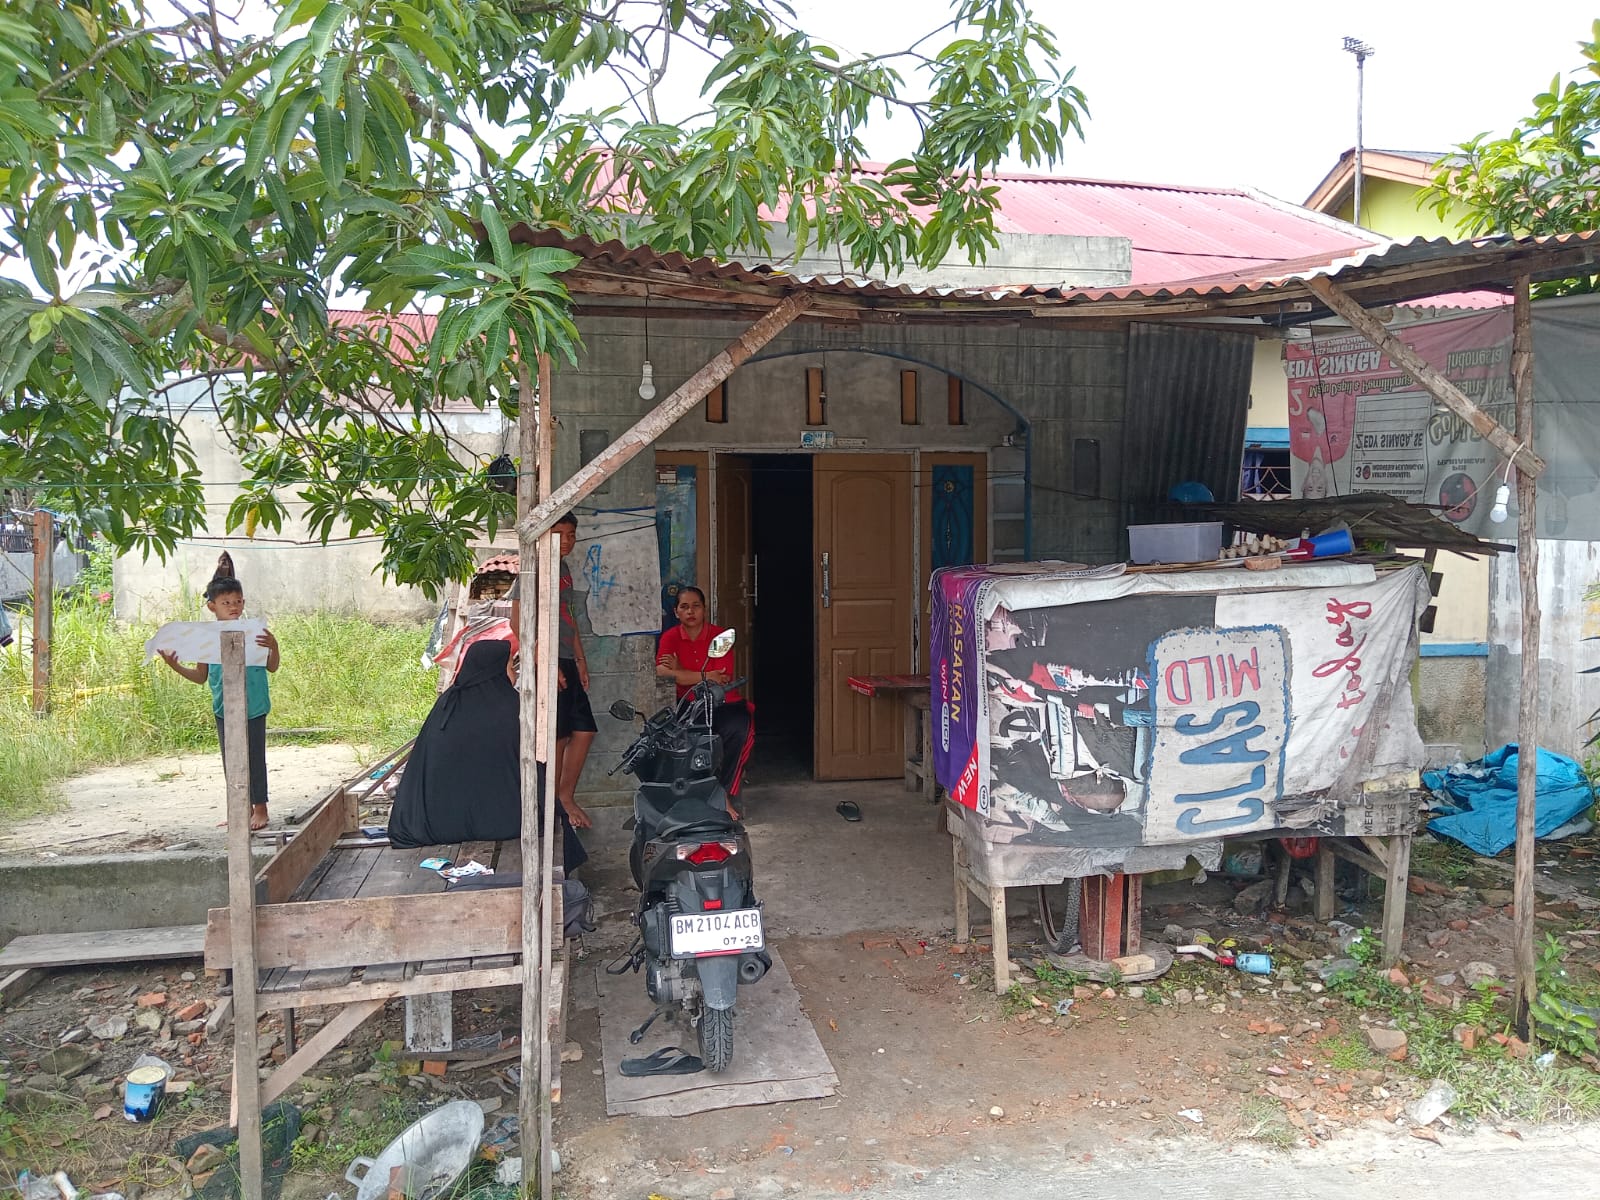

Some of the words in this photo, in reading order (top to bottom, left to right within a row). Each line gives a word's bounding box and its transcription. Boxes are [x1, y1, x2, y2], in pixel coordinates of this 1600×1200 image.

[950, 604, 965, 722] RASAKAN
[942, 705, 950, 747] CLICK
[956, 757, 977, 802] NEW
[1174, 700, 1270, 834] CLAS
[675, 919, 694, 935] BM
[697, 915, 731, 932] 2104
[734, 913, 759, 930] ACB
